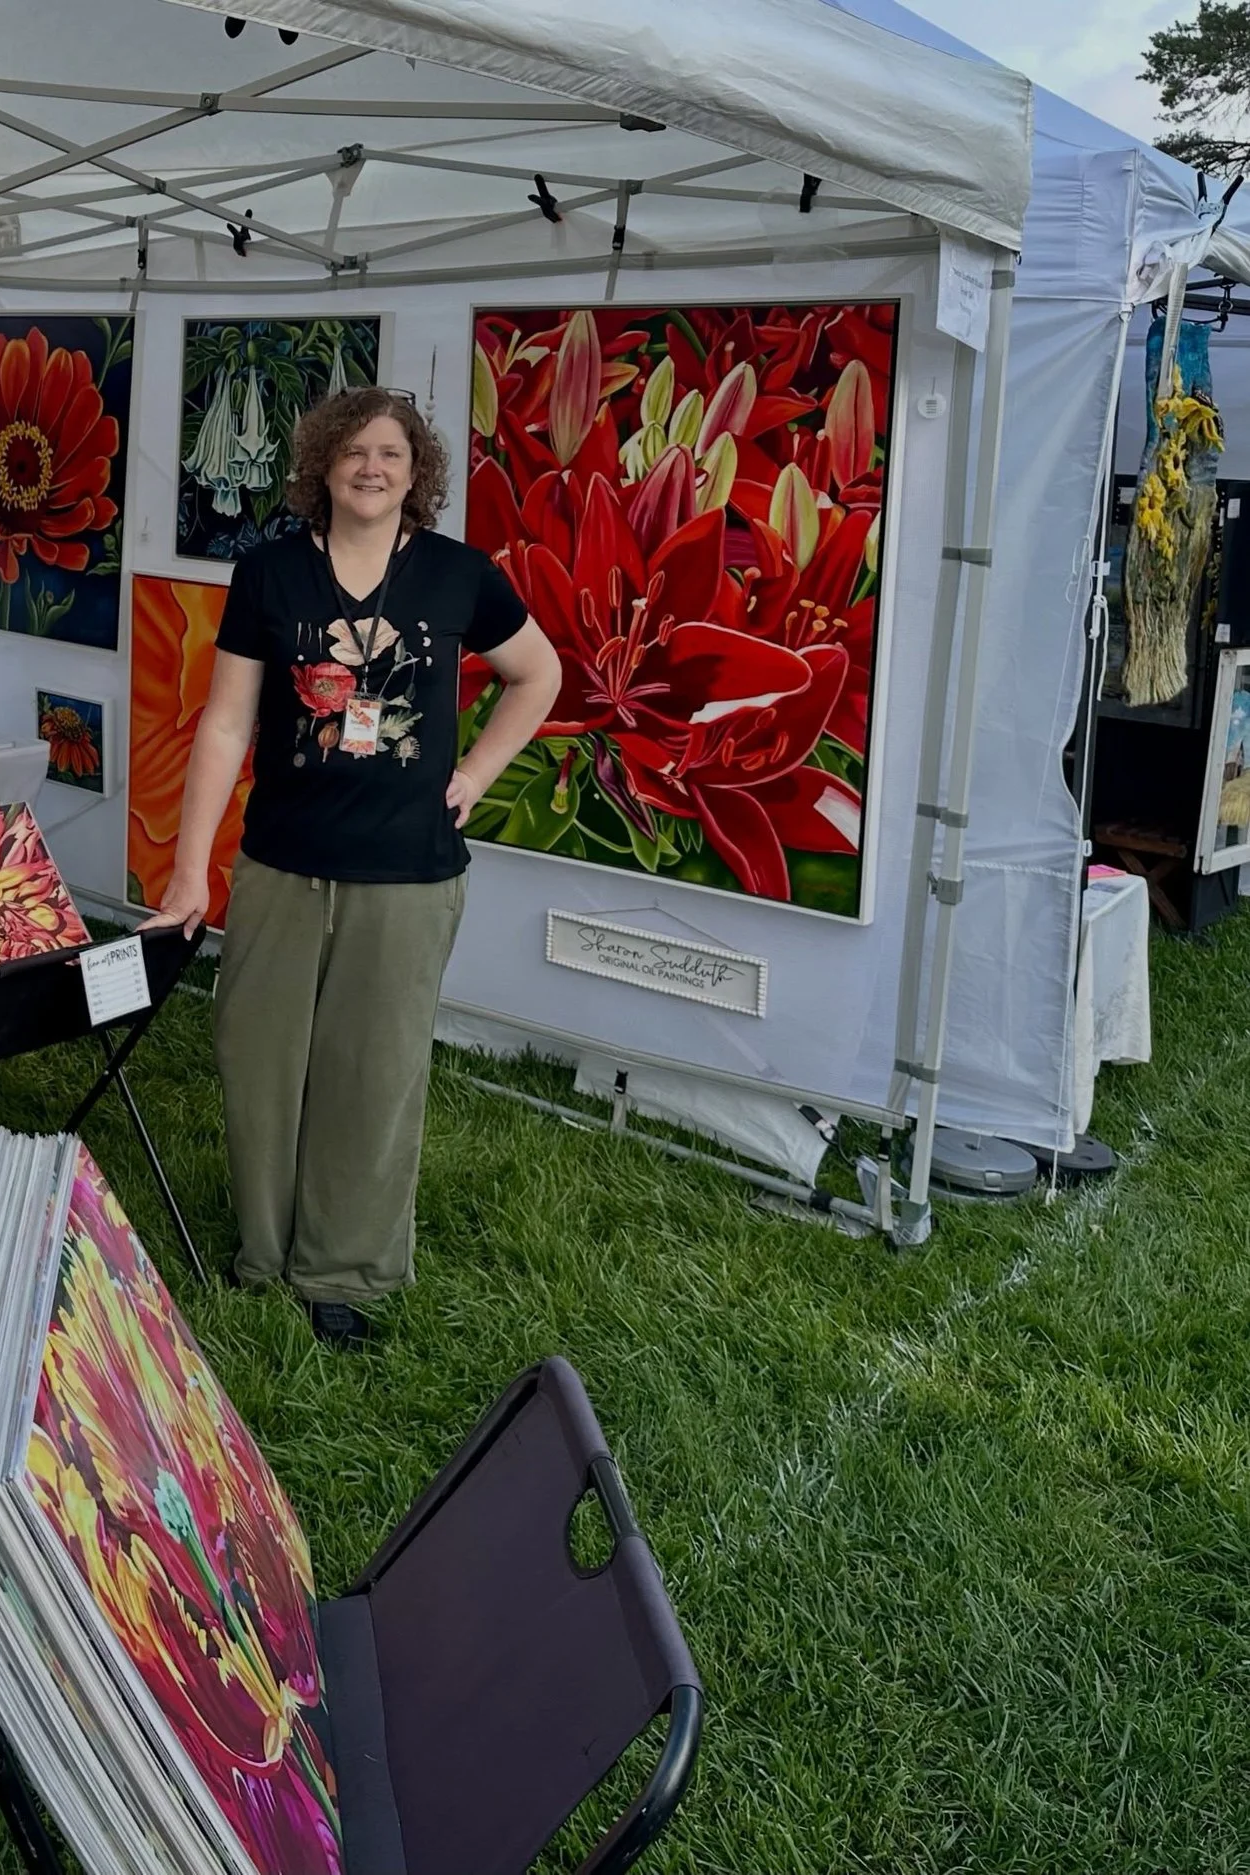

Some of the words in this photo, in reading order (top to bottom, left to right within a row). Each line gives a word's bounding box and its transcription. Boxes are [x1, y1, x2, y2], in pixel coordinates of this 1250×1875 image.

[110, 944, 138, 965] PRINTS
[578, 926, 643, 960] Sharon
[650, 945, 746, 987] Sudduth
[598, 954, 640, 972] ORIGINAL
[642, 965, 656, 977] OIL
[658, 969, 705, 989] PAINTINGS
